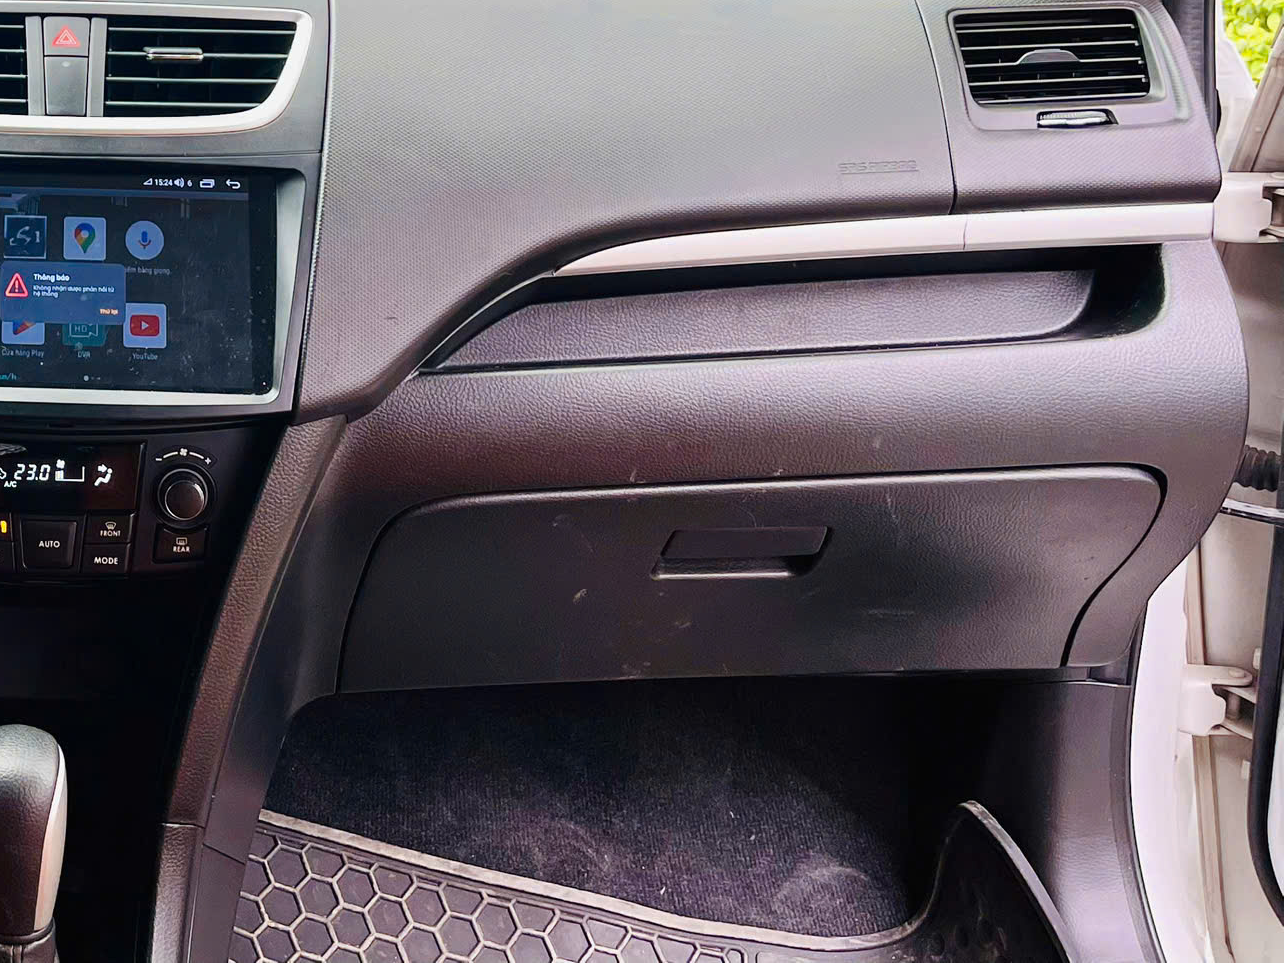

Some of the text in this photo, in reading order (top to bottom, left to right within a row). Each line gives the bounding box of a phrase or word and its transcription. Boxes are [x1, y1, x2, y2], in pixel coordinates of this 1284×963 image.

[154, 178, 193, 188] 15:24 6
[33, 273, 70, 283] Thông báo
[74, 324, 88, 334] HD
[31, 349, 45, 359] Play
[132, 353, 159, 361] YouTube
[13, 463, 51, 481] 23.0
[3, 480, 18, 488] A/C
[100, 529, 121, 537] FRONT
[38, 540, 61, 548] AUTO
[172, 545, 191, 553] REAR
[93, 556, 119, 565] MODE
